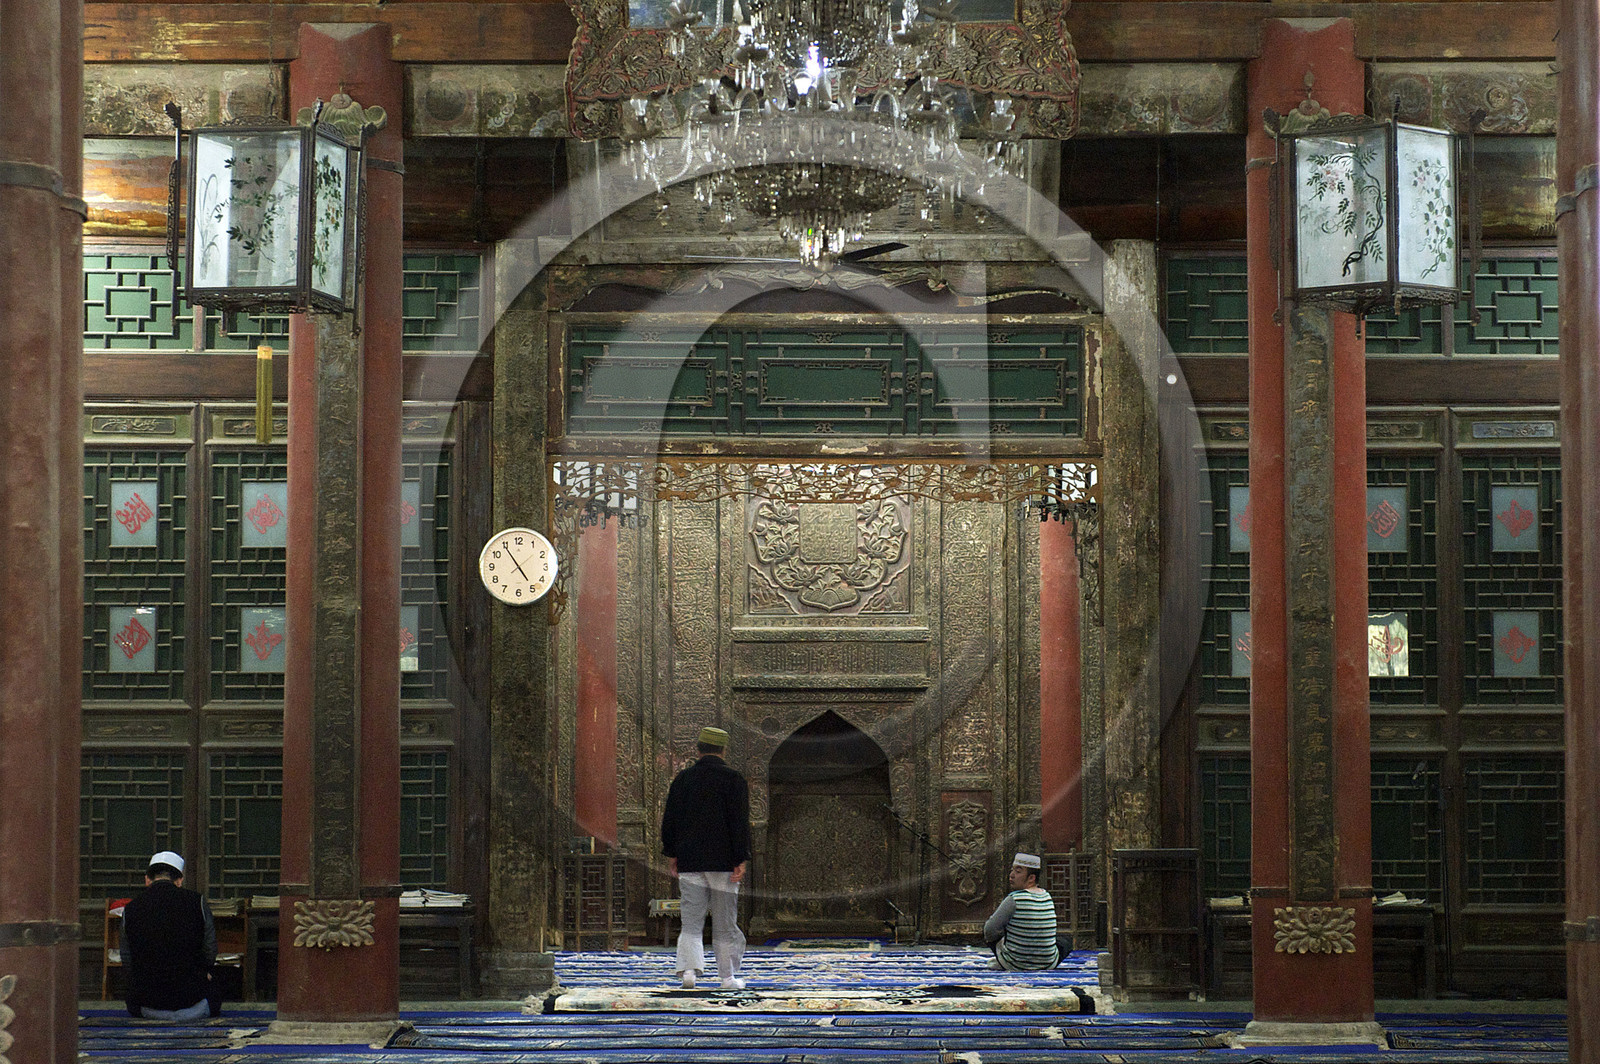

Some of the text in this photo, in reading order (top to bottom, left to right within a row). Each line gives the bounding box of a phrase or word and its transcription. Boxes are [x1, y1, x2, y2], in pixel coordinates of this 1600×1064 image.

[502, 541, 508, 549] 11
[514, 537, 523, 545] 12
[492, 550, 501, 559] 10
[540, 550, 545, 559] 2
[488, 562, 495, 571] 9
[543, 563, 548, 571] 3
[492, 575, 499, 583] 8
[539, 575, 545, 583] 4
[502, 585, 507, 593] 7
[515, 589, 522, 597] 6
[529, 585, 536, 593] 5
